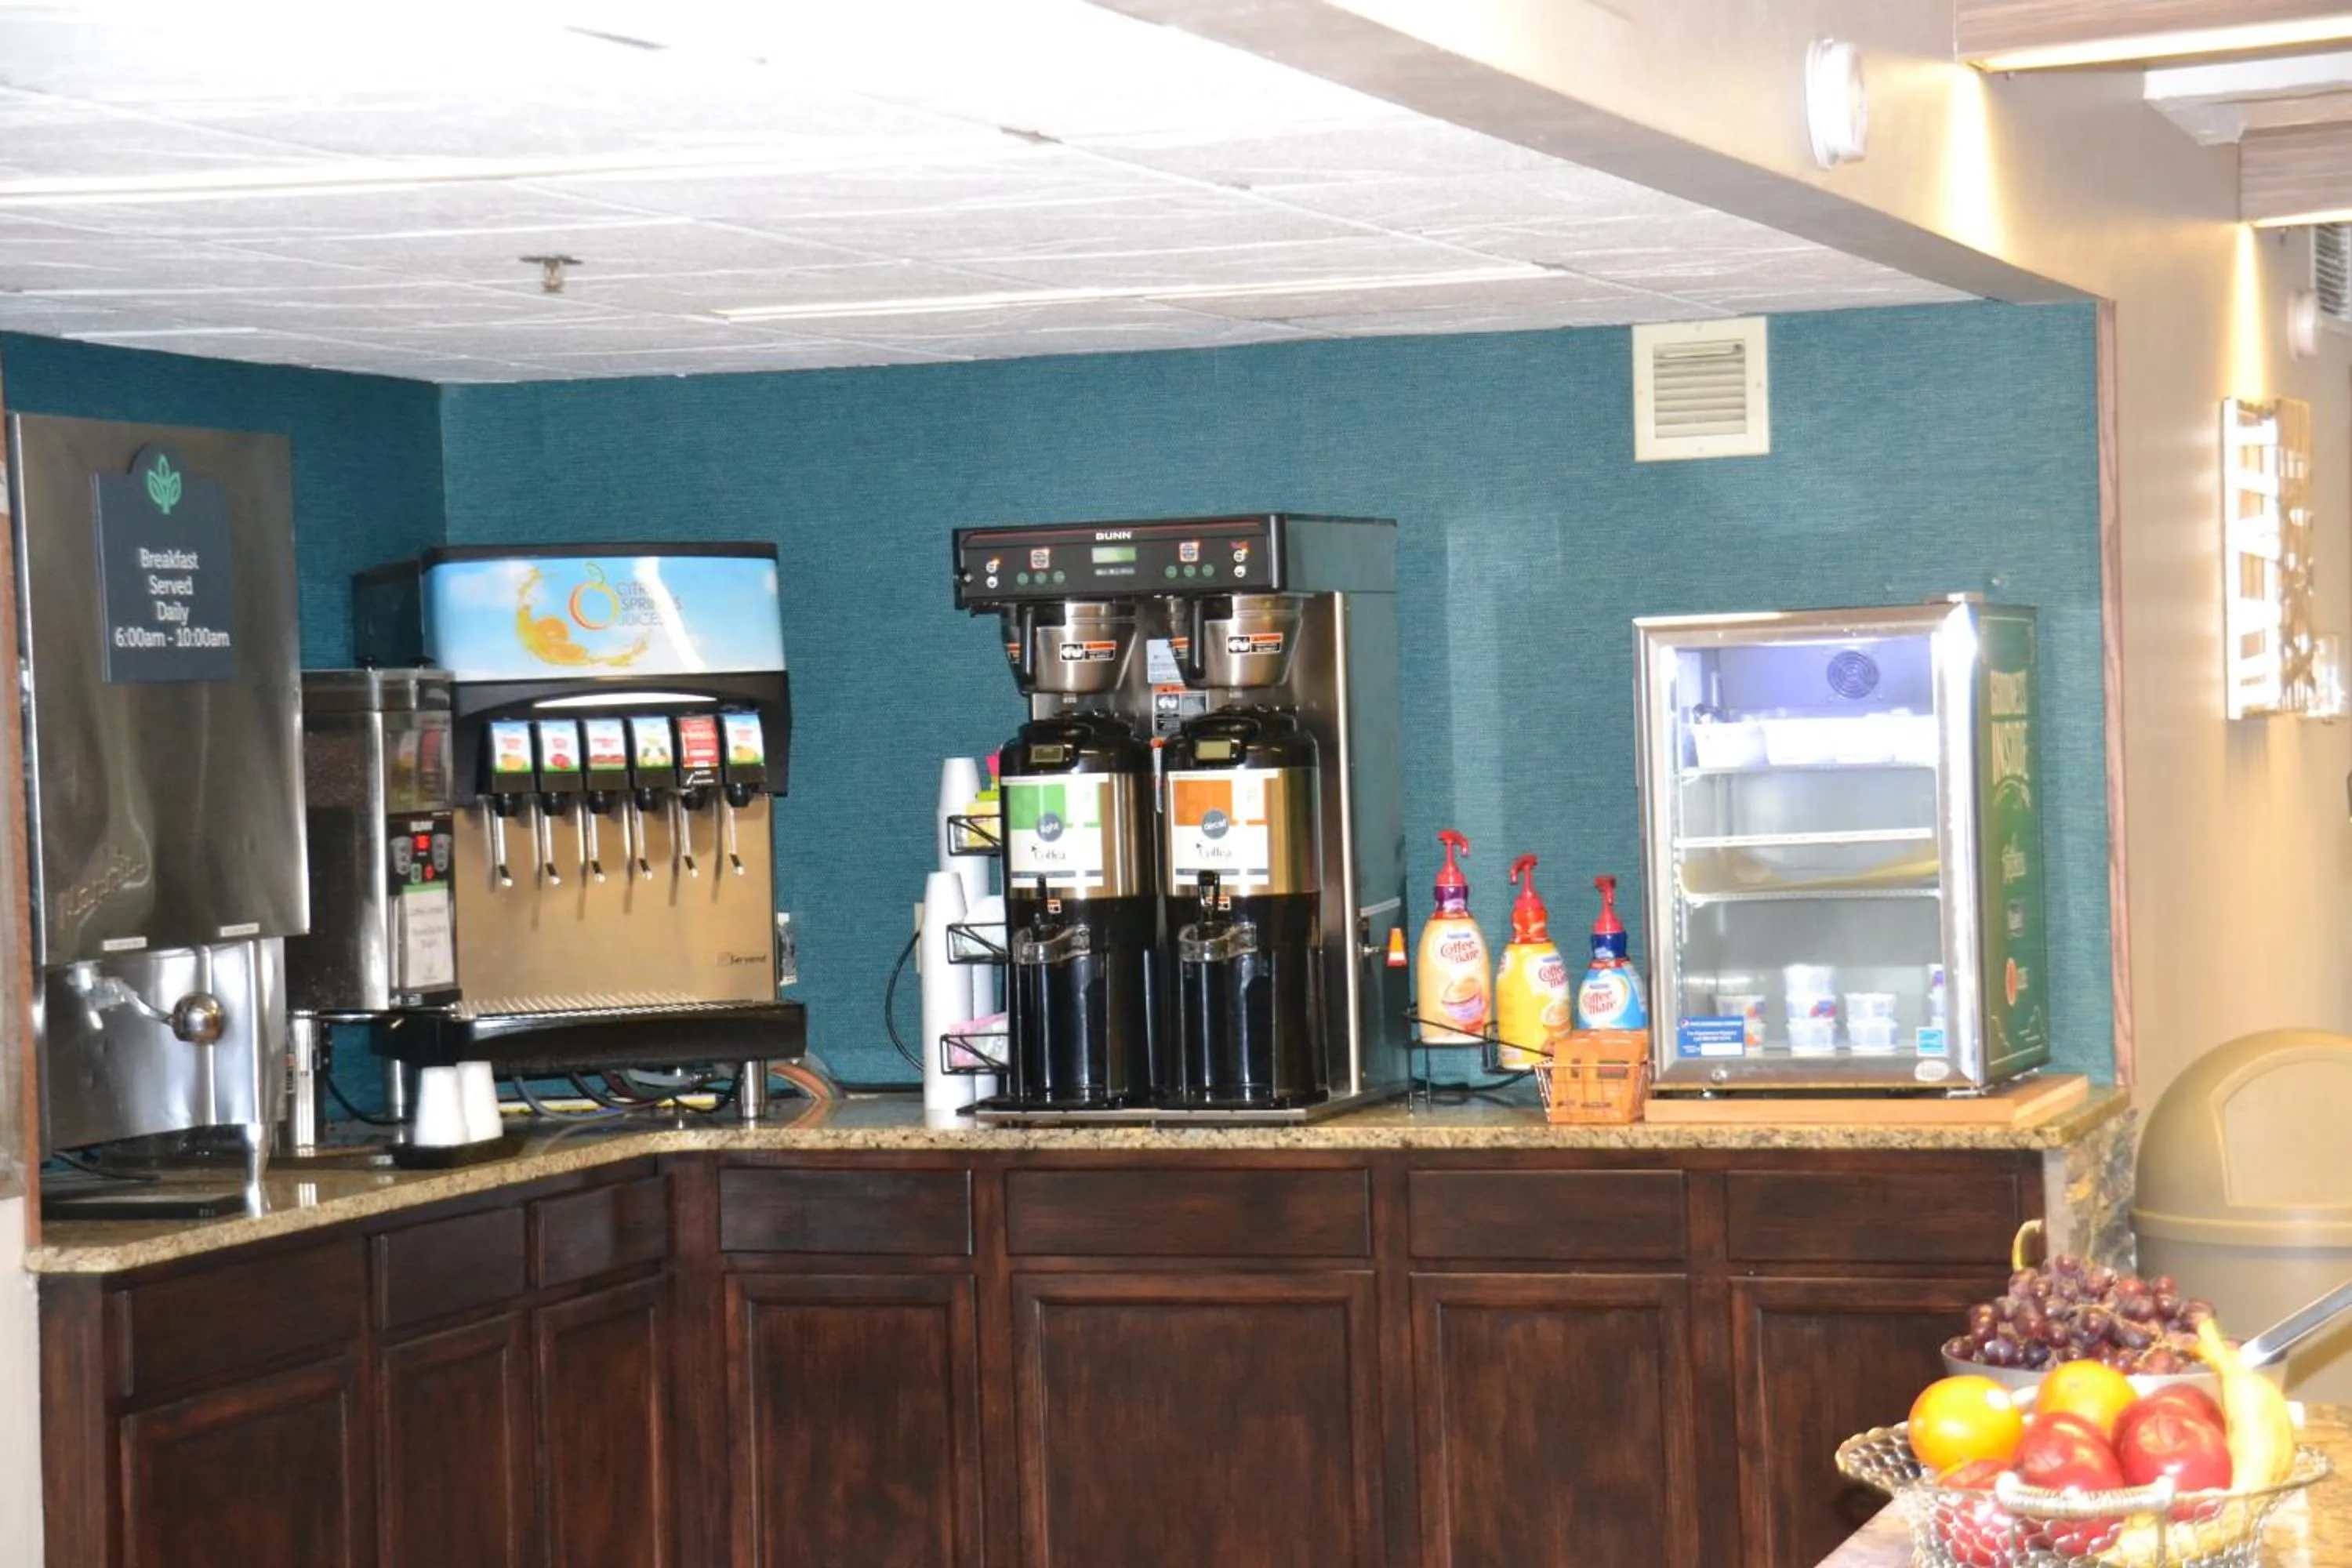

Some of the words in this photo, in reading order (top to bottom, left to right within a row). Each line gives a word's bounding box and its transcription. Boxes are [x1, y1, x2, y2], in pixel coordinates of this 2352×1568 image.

[1095, 531, 1132, 541] BUNN
[139, 547, 199, 570] Breakfast
[148, 574, 194, 595] Served
[616, 581, 657, 596] CITR
[619, 597, 683, 611] SPRIS
[156, 601, 190, 626] Daily
[114, 627, 167, 648] 6:00am
[175, 627, 230, 648] 10:00am
[1039, 819, 1059, 835] light
[1440, 941, 1475, 958] Coffee
